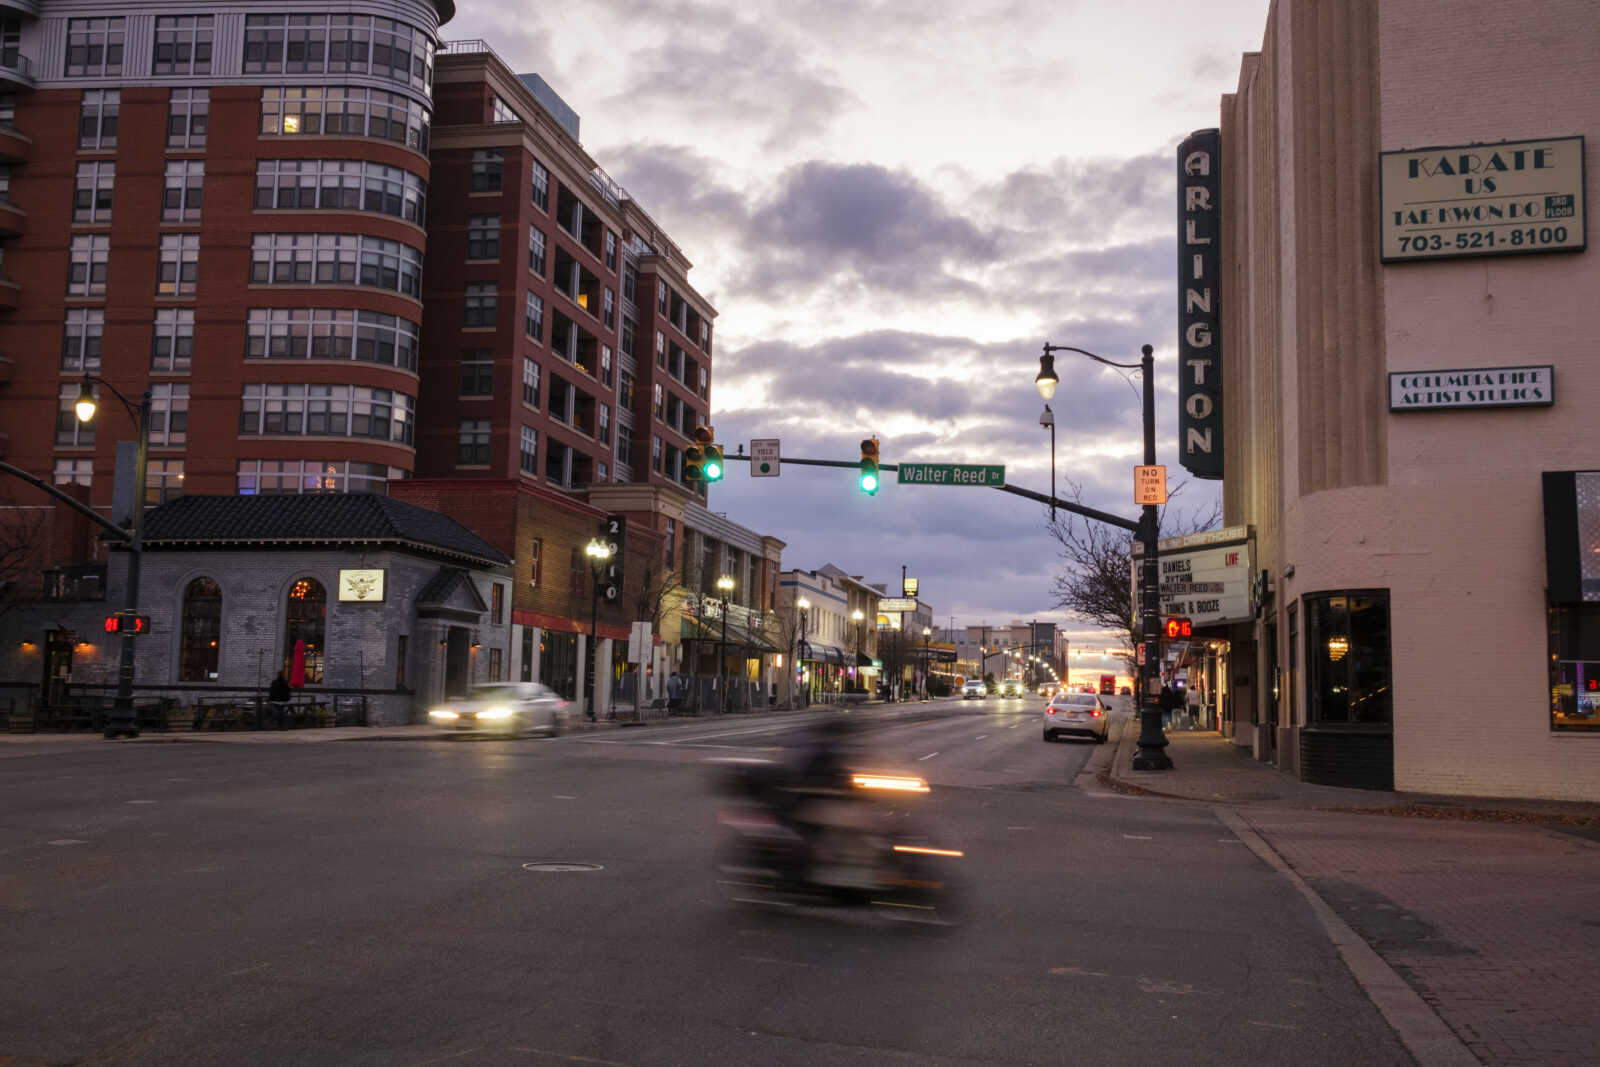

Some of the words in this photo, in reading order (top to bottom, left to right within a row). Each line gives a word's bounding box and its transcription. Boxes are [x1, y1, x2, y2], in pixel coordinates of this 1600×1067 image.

[1408, 148, 1555, 178] KARATE
[1465, 176, 1497, 194] US
[1184, 151, 1214, 454] ARLINGTON
[1400, 374, 1494, 389] COLUMBIA
[1499, 372, 1542, 385] PIKE
[1401, 390, 1463, 404] ARTIST
[1467, 387, 1543, 402] STUDIOS
[903, 466, 948, 481] Walter
[953, 467, 986, 483] Reed
[991, 471, 1000, 480] Dr
[1142, 469, 1157, 477] NO
[1145, 486, 1156, 494] ON
[1162, 559, 1192, 574] DANIELS
[1224, 552, 1239, 567] LIVE
[1189, 582, 1209, 593] REED
[1197, 599, 1220, 614] BOOZE
